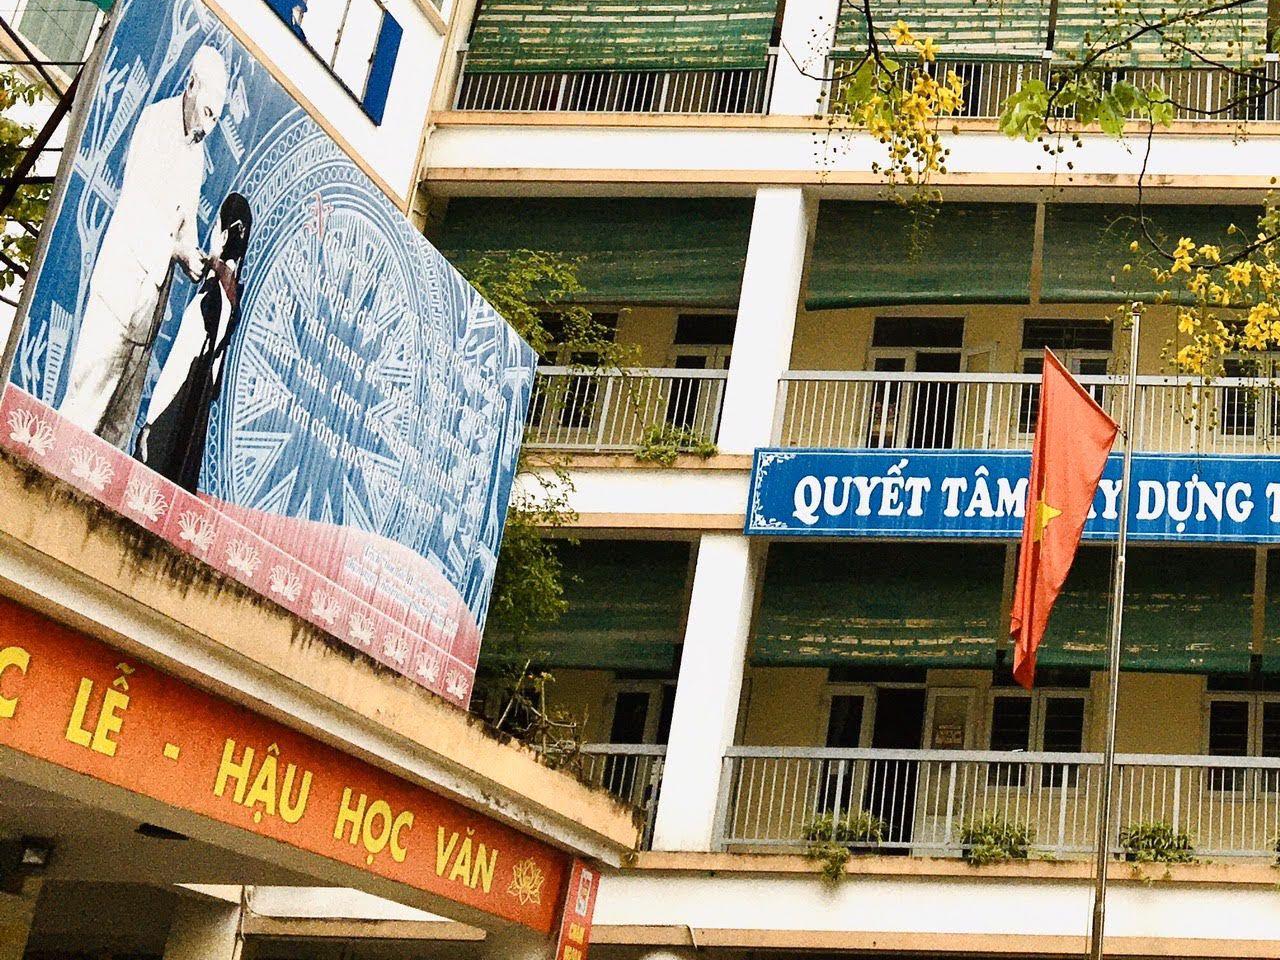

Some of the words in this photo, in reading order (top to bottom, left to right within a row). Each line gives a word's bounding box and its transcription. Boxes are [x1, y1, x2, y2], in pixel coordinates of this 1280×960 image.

[325, 330, 364, 382] quang
[792, 459, 931, 525] QUYẾT
[941, 466, 1028, 518] TÂM
[1136, 473, 1254, 533] DỰNG
[65, 662, 136, 757] LỄ
[213, 738, 313, 824] HẬU
[333, 786, 415, 865] HỌC
[435, 826, 499, 894] VĂN
